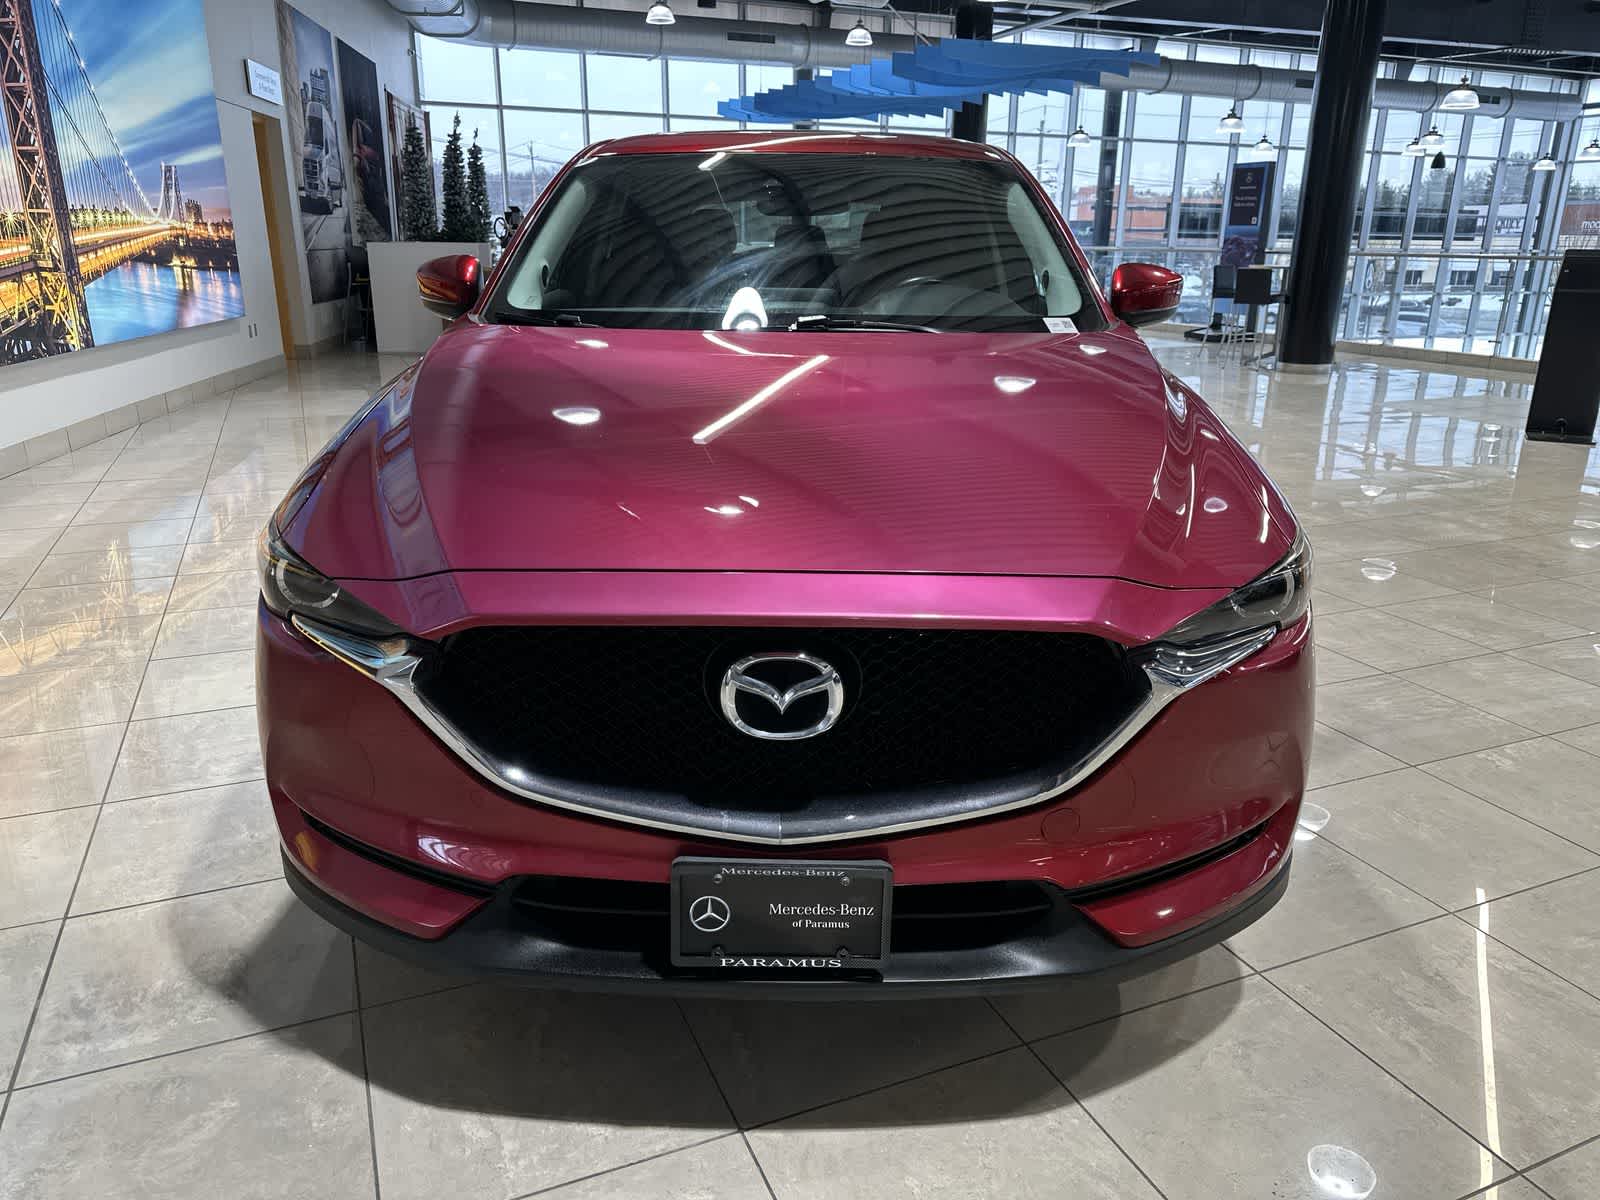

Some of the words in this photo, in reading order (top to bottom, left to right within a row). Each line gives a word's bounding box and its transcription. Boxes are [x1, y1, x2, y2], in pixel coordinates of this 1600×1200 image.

[721, 866, 848, 878] Mercedes-Benz
[769, 903, 874, 916] Mercedes-Benz
[792, 919, 803, 928] of
[805, 919, 850, 929] Paramus
[720, 958, 842, 968] PARAMUS
